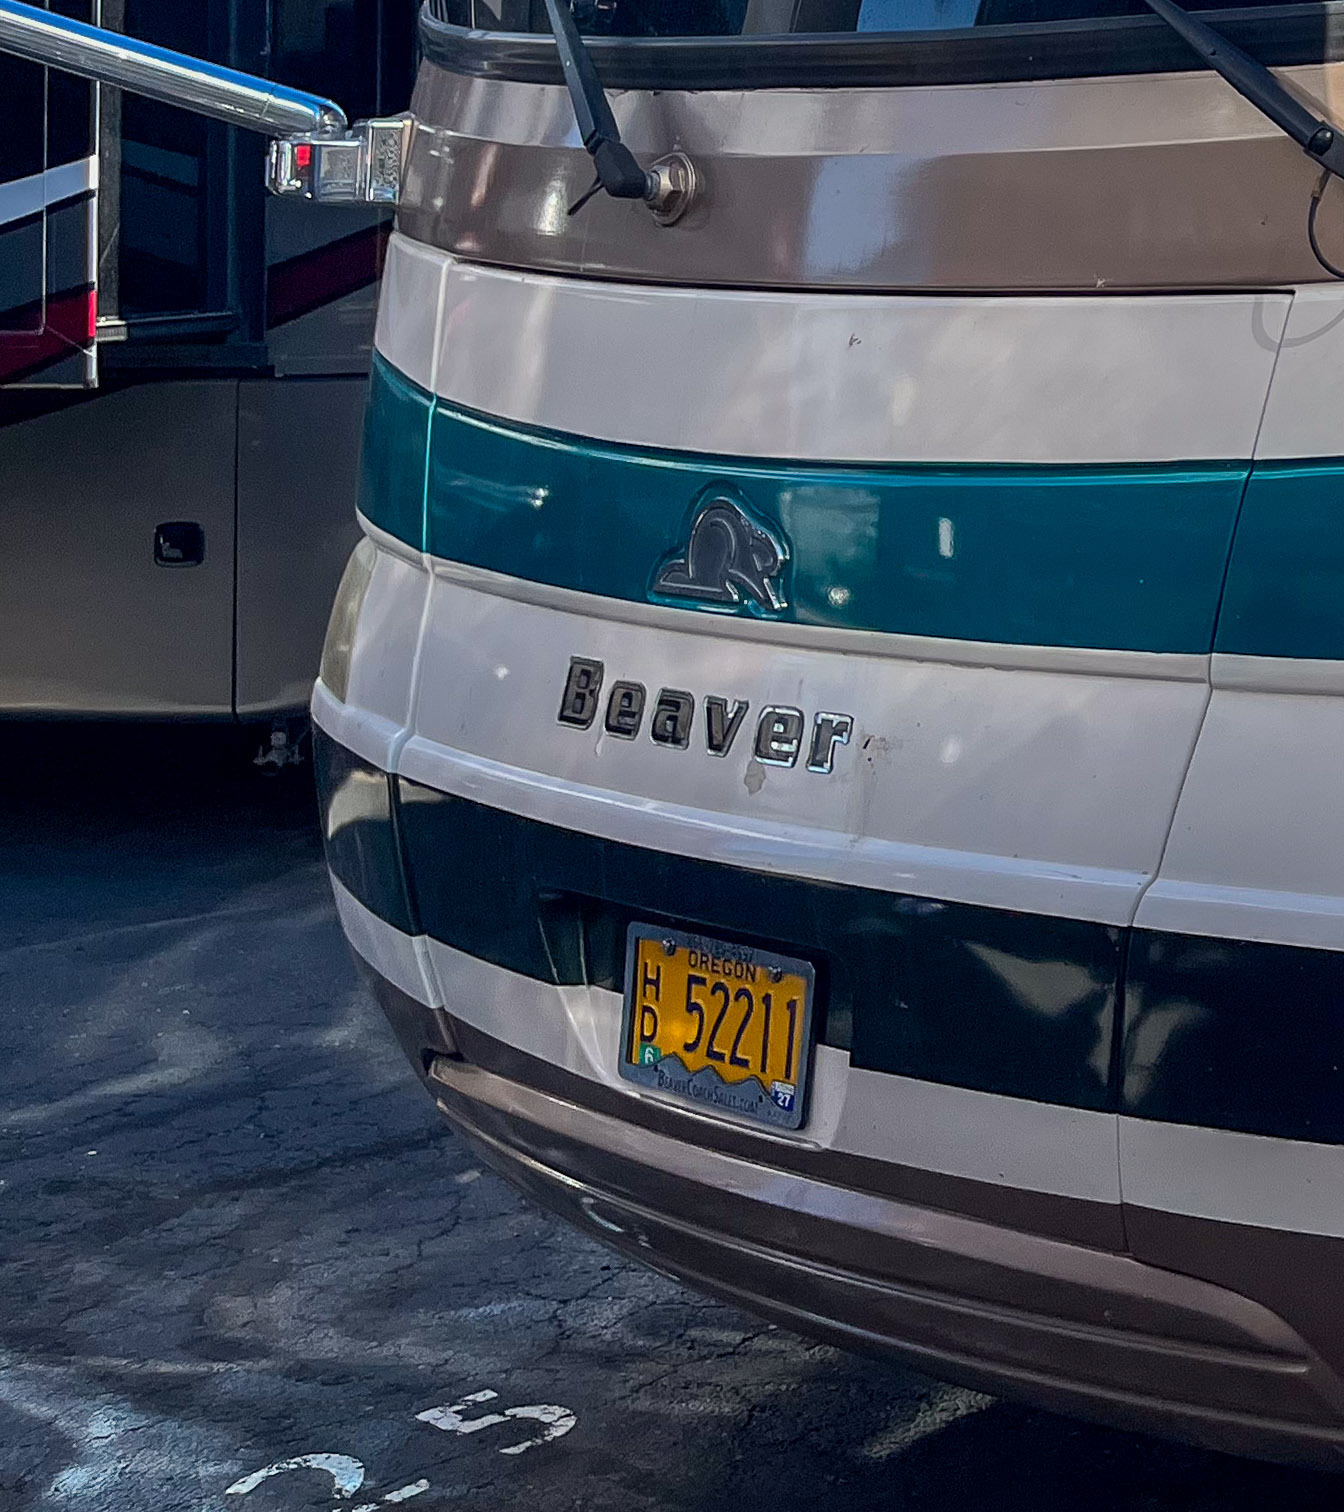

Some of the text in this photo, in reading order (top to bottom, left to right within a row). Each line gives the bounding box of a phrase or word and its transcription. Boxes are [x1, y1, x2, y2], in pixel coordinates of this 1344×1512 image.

[556, 655, 855, 774] Beaver
[688, 950, 757, 982] OREGON
[641, 961, 797, 1080] HD 52211
[644, 1046, 655, 1064] 6
[777, 1092, 791, 1107] 27
